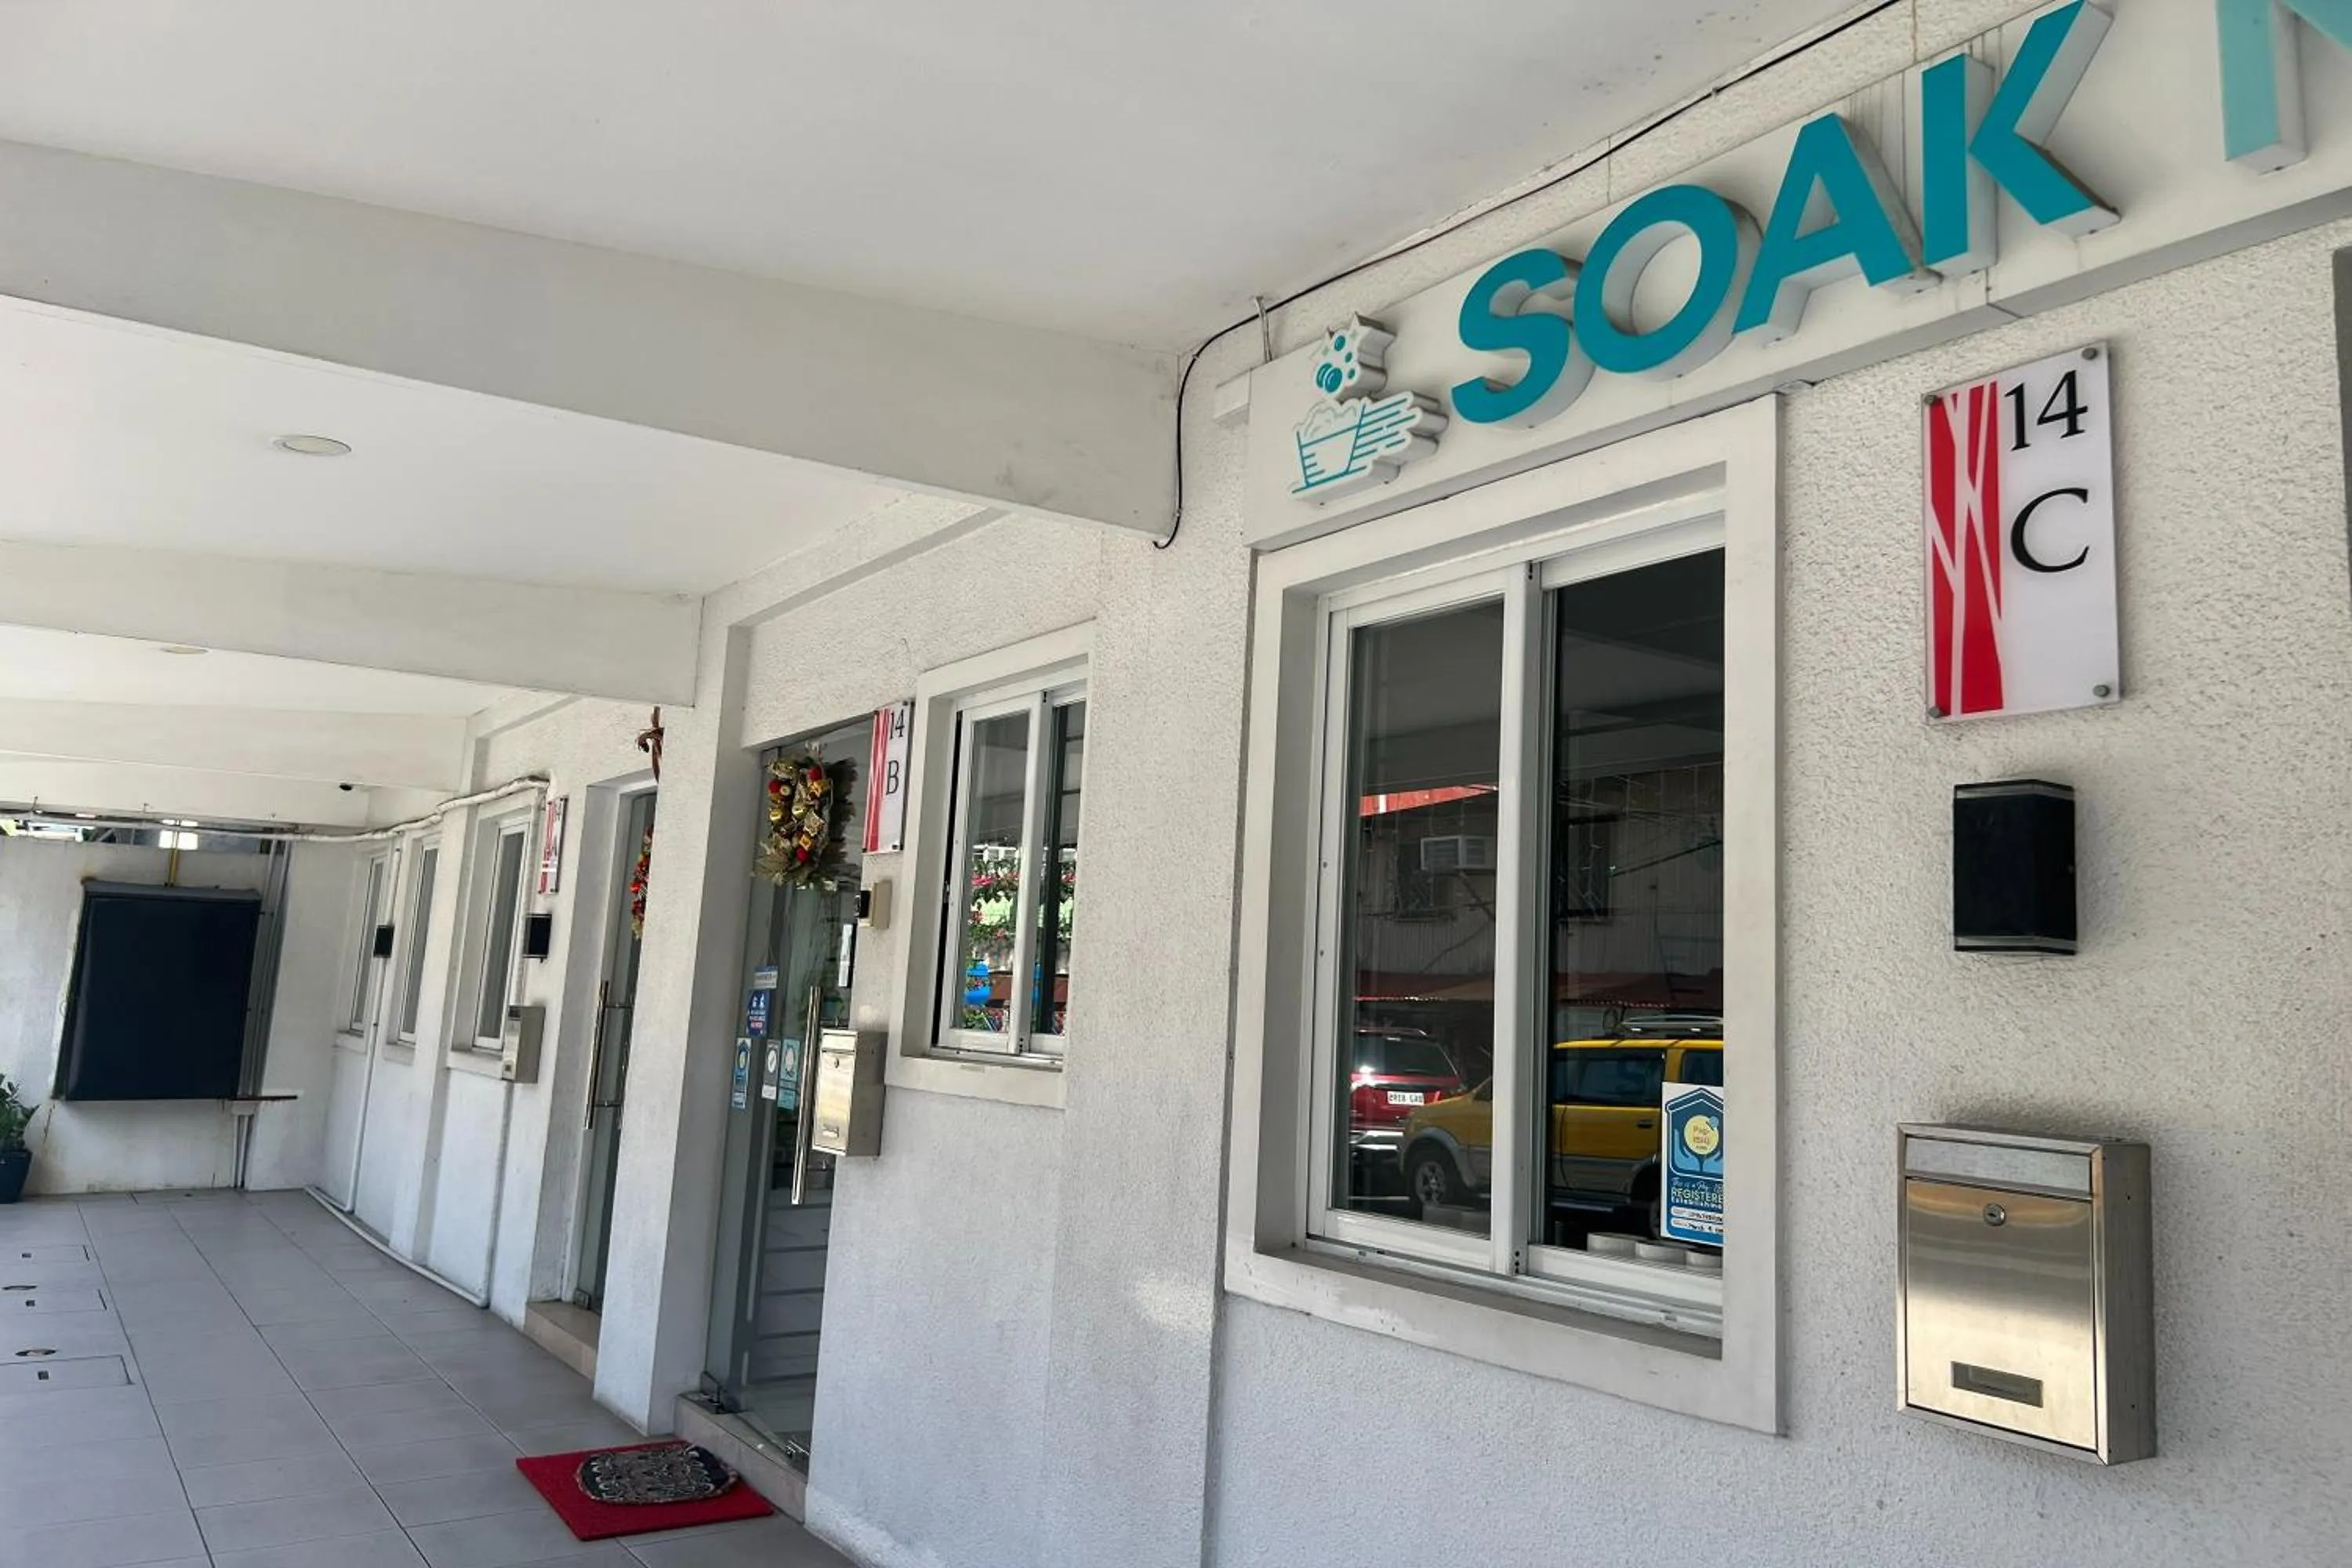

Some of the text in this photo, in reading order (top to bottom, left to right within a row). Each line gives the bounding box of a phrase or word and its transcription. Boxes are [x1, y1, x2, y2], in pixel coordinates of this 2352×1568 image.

[1452, 0, 2092, 424] SOAK
[2004, 368, 2089, 452] 14
[2010, 487, 2090, 574] C
[889, 708, 905, 740] 14
[886, 760, 899, 796] B
